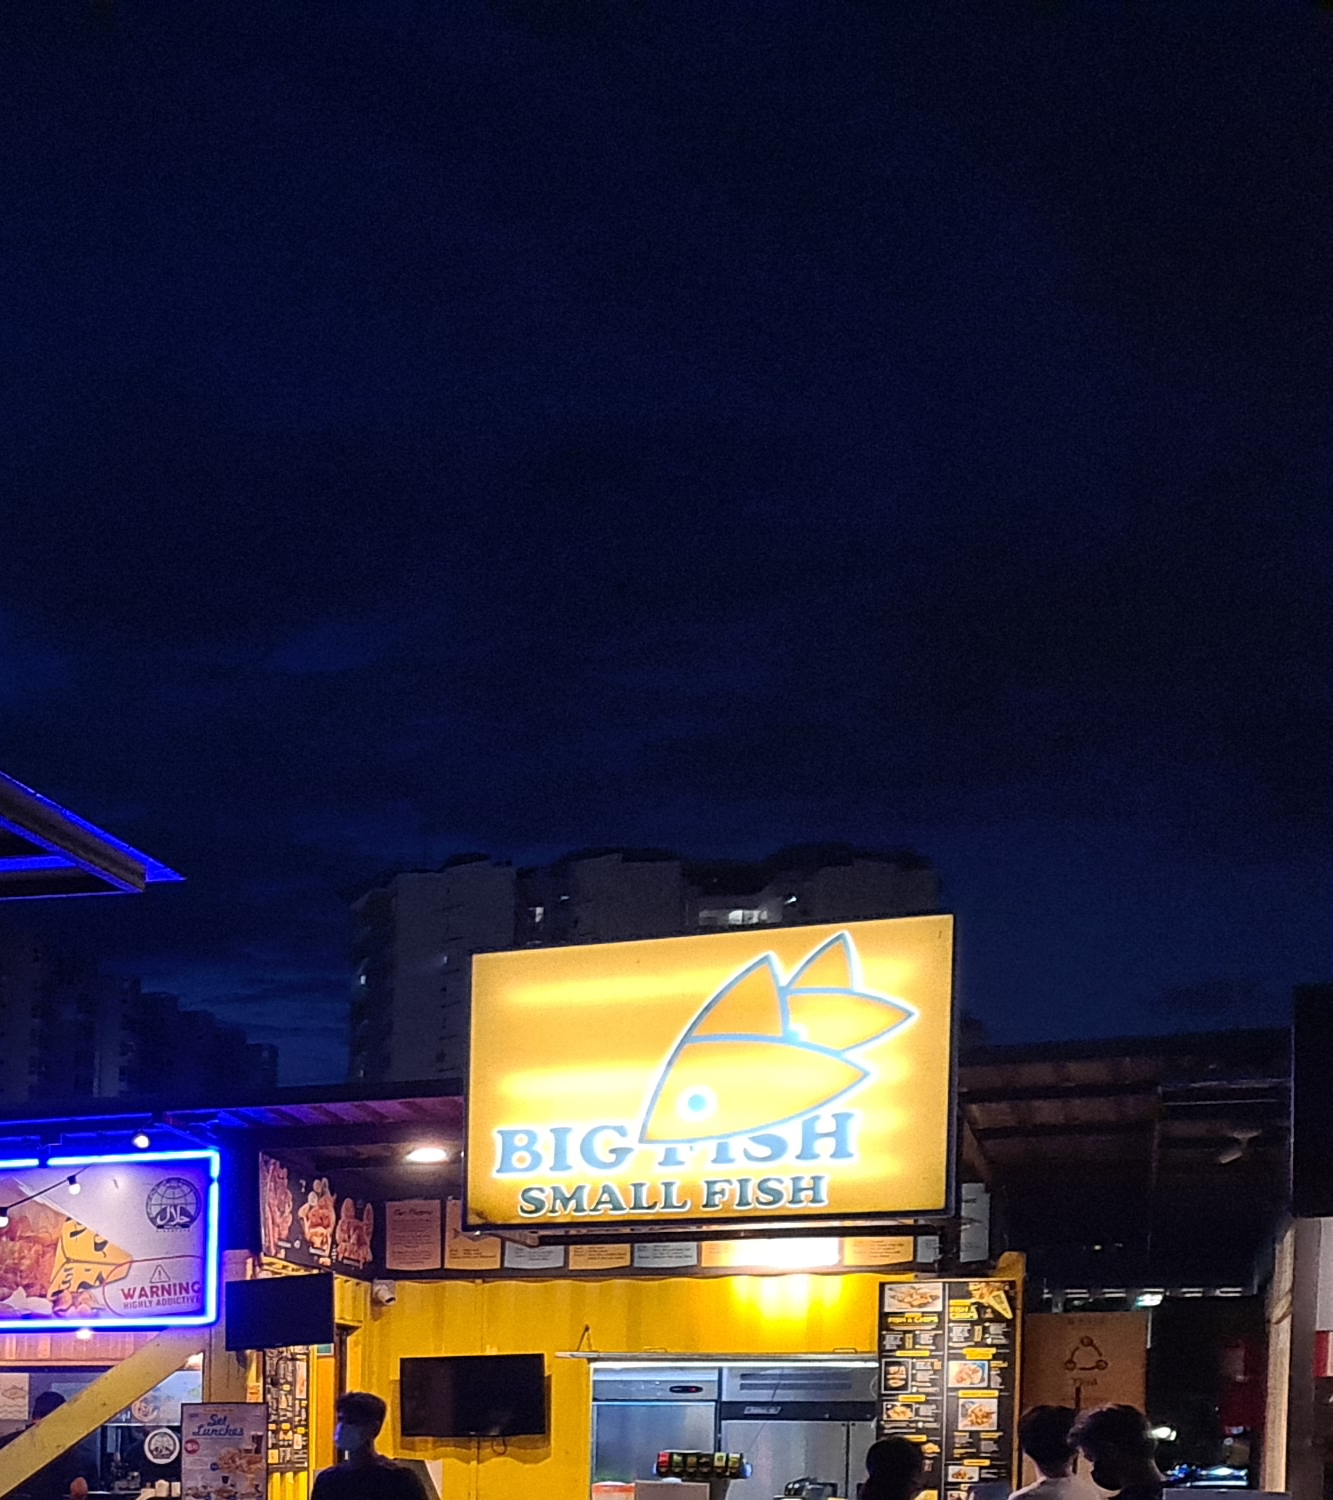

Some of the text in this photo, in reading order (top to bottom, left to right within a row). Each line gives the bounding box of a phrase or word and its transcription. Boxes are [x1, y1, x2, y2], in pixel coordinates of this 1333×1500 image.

[495, 1124, 635, 1175] BIG
[518, 1174, 828, 1217] SMALL FISH
[120, 1280, 202, 1301] WARNING
[123, 1295, 201, 1310] HIGHLY ADDICTIVE
[207, 1413, 228, 1427] Set
[192, 1424, 244, 1437] Lunches
